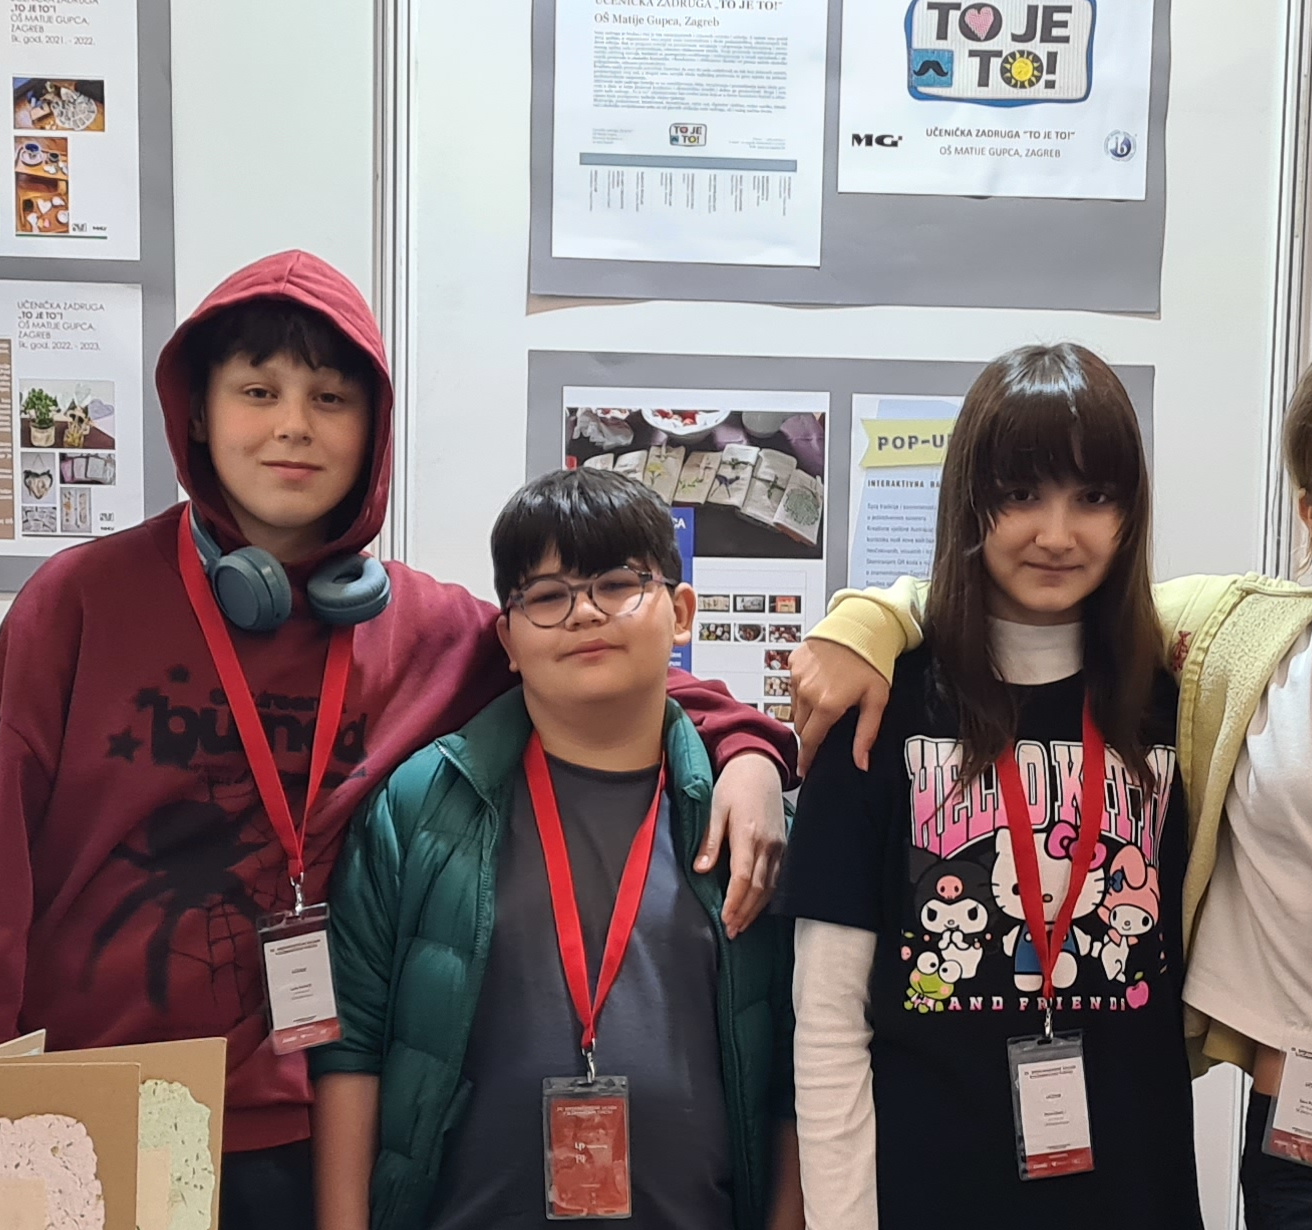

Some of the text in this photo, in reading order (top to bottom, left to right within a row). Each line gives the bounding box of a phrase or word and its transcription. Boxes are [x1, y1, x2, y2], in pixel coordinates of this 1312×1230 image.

[738, 0, 754, 10] JE
[25, 15, 54, 23] MATIJE
[594, 13, 720, 28] OŠ Matije Gupca, Zagreb
[927, 2, 1072, 44] TO JE
[11, 25, 44, 33] ZAGREB
[968, 49, 1058, 89] TO!
[926, 126, 973, 139] UČENIČKA
[975, 129, 1020, 139] ZADRUGA
[1043, 131, 1054, 140] JE
[939, 145, 952, 156] OŠ
[954, 147, 986, 156] MATIJE
[1025, 149, 1061, 158] ZAGREB
[63, 303, 105, 312] ZADRUGA
[32, 322, 60, 330] MATIJE
[877, 434, 951, 450] POP-U
[868, 480, 924, 488] INTERAKTIVNA
[948, 996, 1126, 1011] AND FRIENDS
